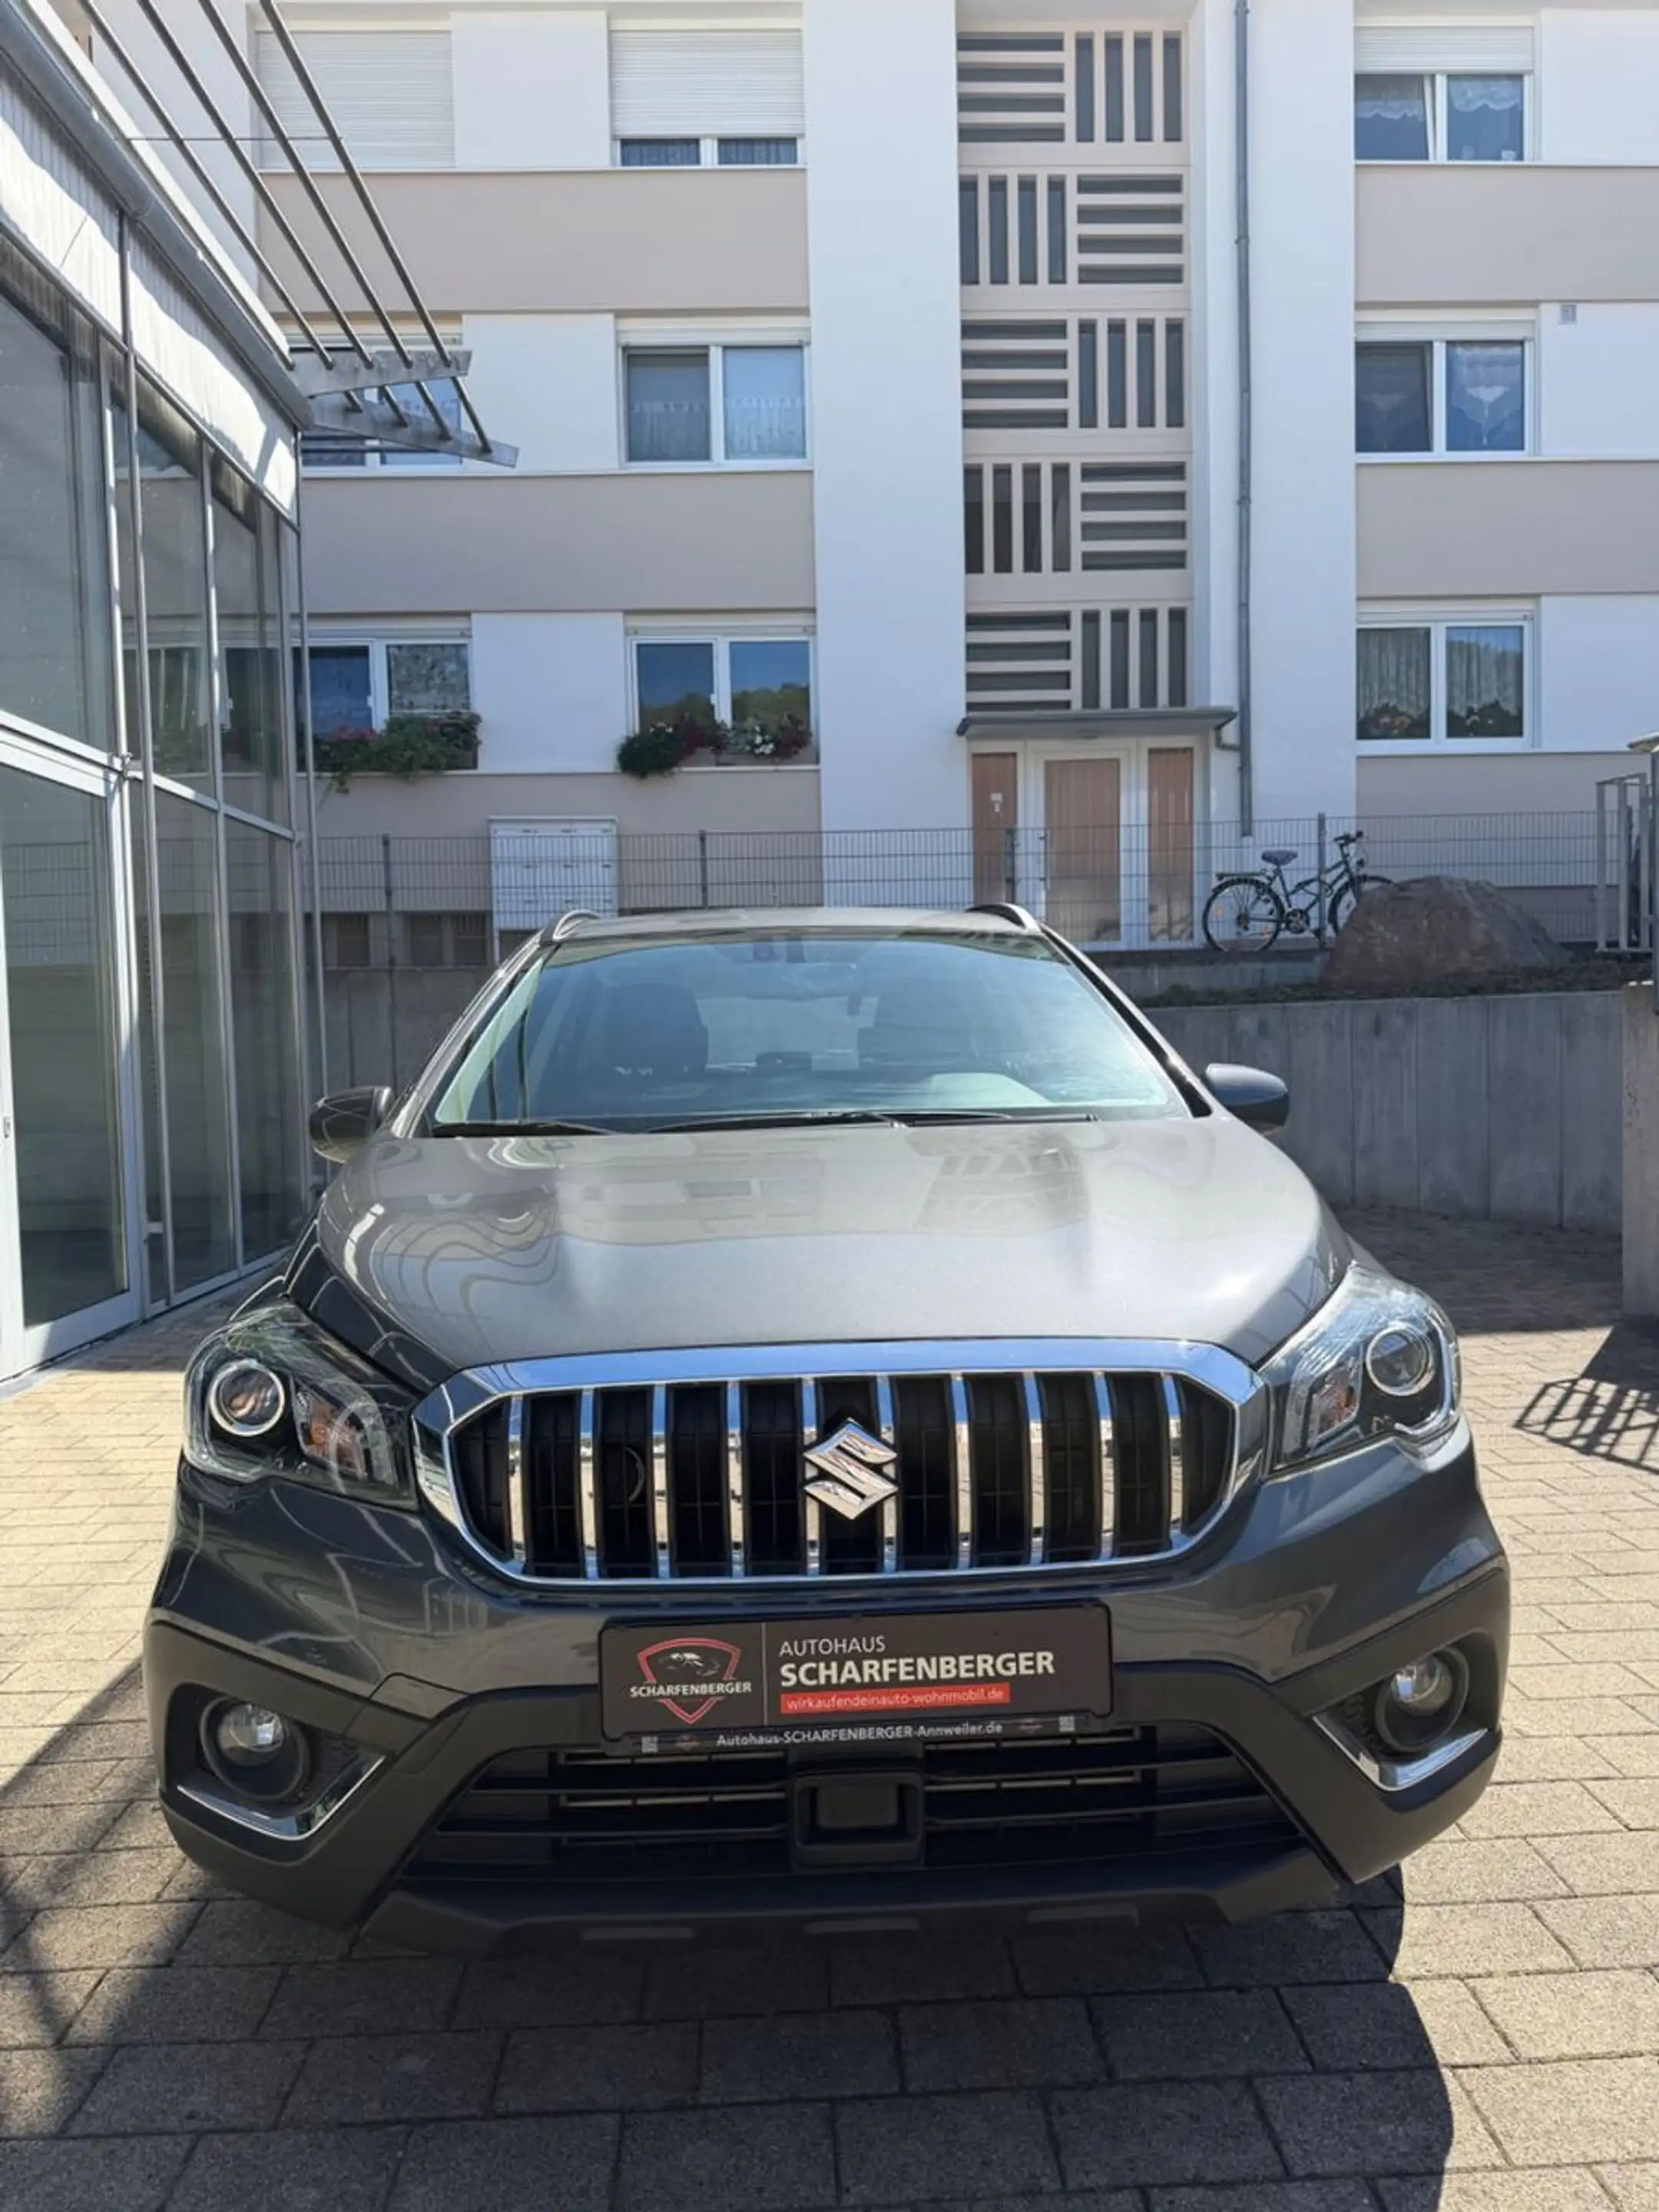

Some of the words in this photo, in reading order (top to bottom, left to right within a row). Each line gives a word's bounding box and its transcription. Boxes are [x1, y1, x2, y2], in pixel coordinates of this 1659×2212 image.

[780, 1635, 886, 1657] AUTOHAUS
[780, 1651, 1055, 1687] SCHARFENBERGER
[630, 1681, 752, 1698] SCHARFENBERGER
[786, 1689, 1004, 1710] wirkaufendeinauto-wohnmobil.de
